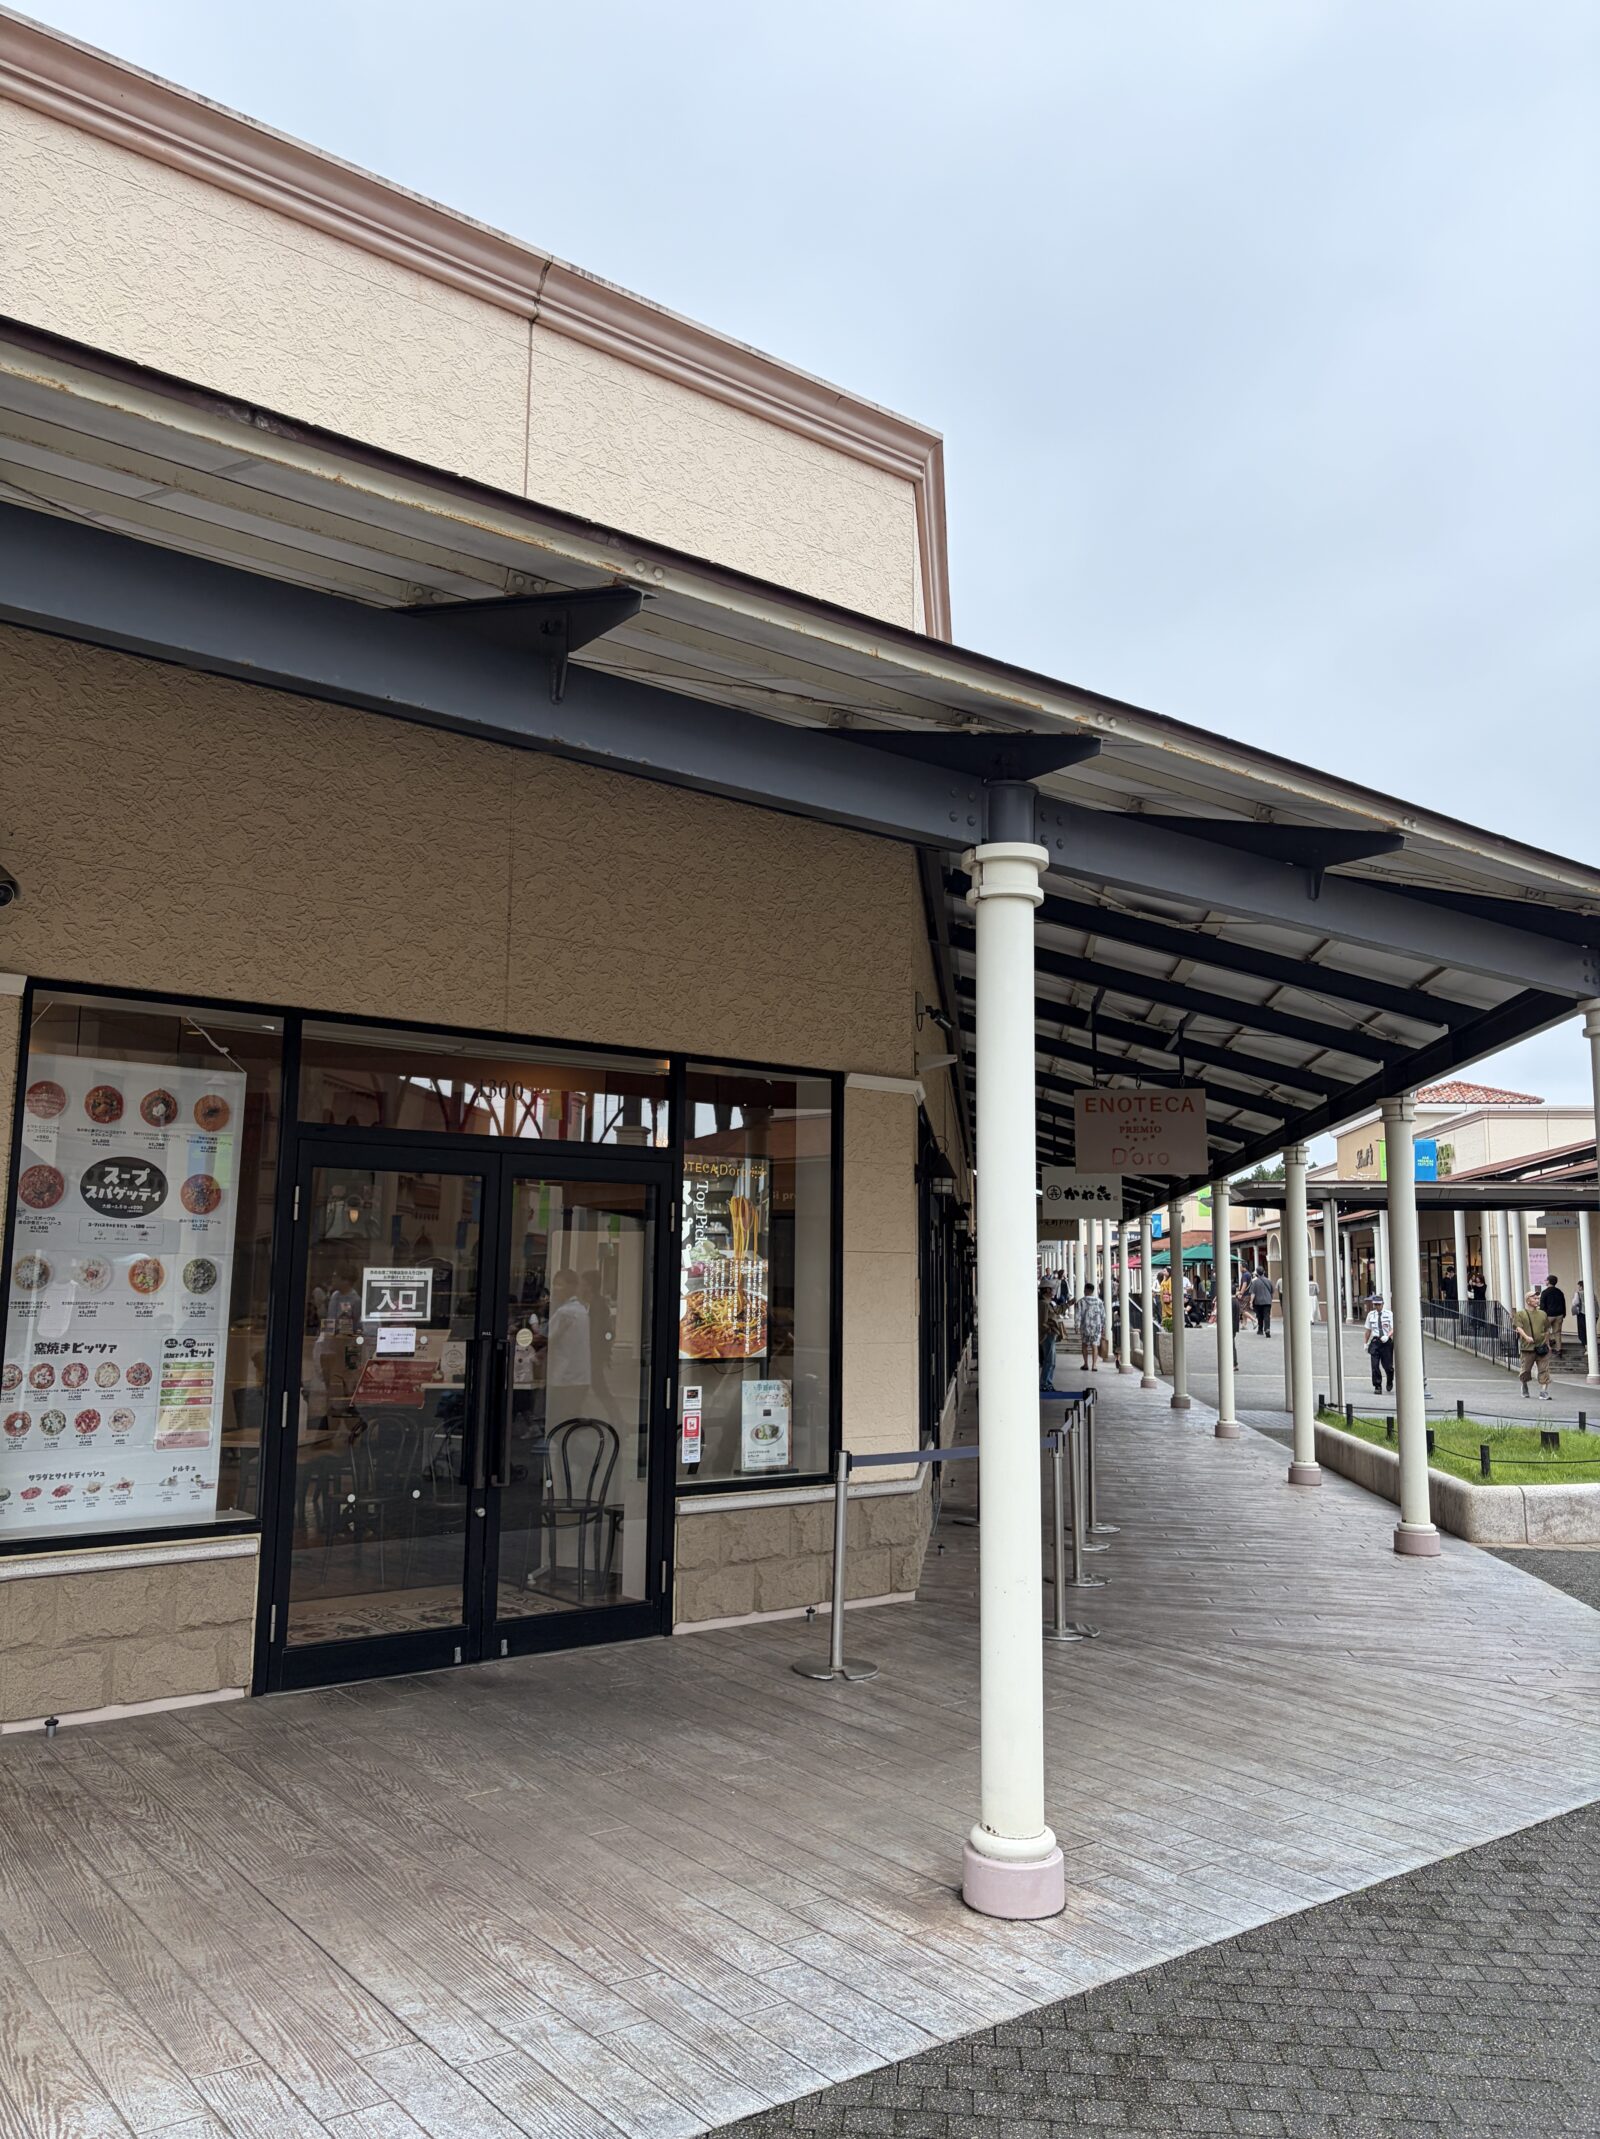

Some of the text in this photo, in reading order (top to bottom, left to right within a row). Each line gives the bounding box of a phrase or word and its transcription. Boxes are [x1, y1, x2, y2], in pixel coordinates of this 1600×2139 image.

[478, 1079, 524, 1101] 1300
[1084, 1096, 1195, 1113] ENOTECA
[1119, 1125, 1162, 1134] PREMIO
[1112, 1146, 1170, 1166] D'oro
[103, 1166, 151, 1186] スープ
[85, 1185, 162, 1202] スパゲッティ
[693, 1180, 709, 1210] Top
[376, 1289, 417, 1311] 入口
[33, 1342, 118, 1355] 窯焼きピッツァ
